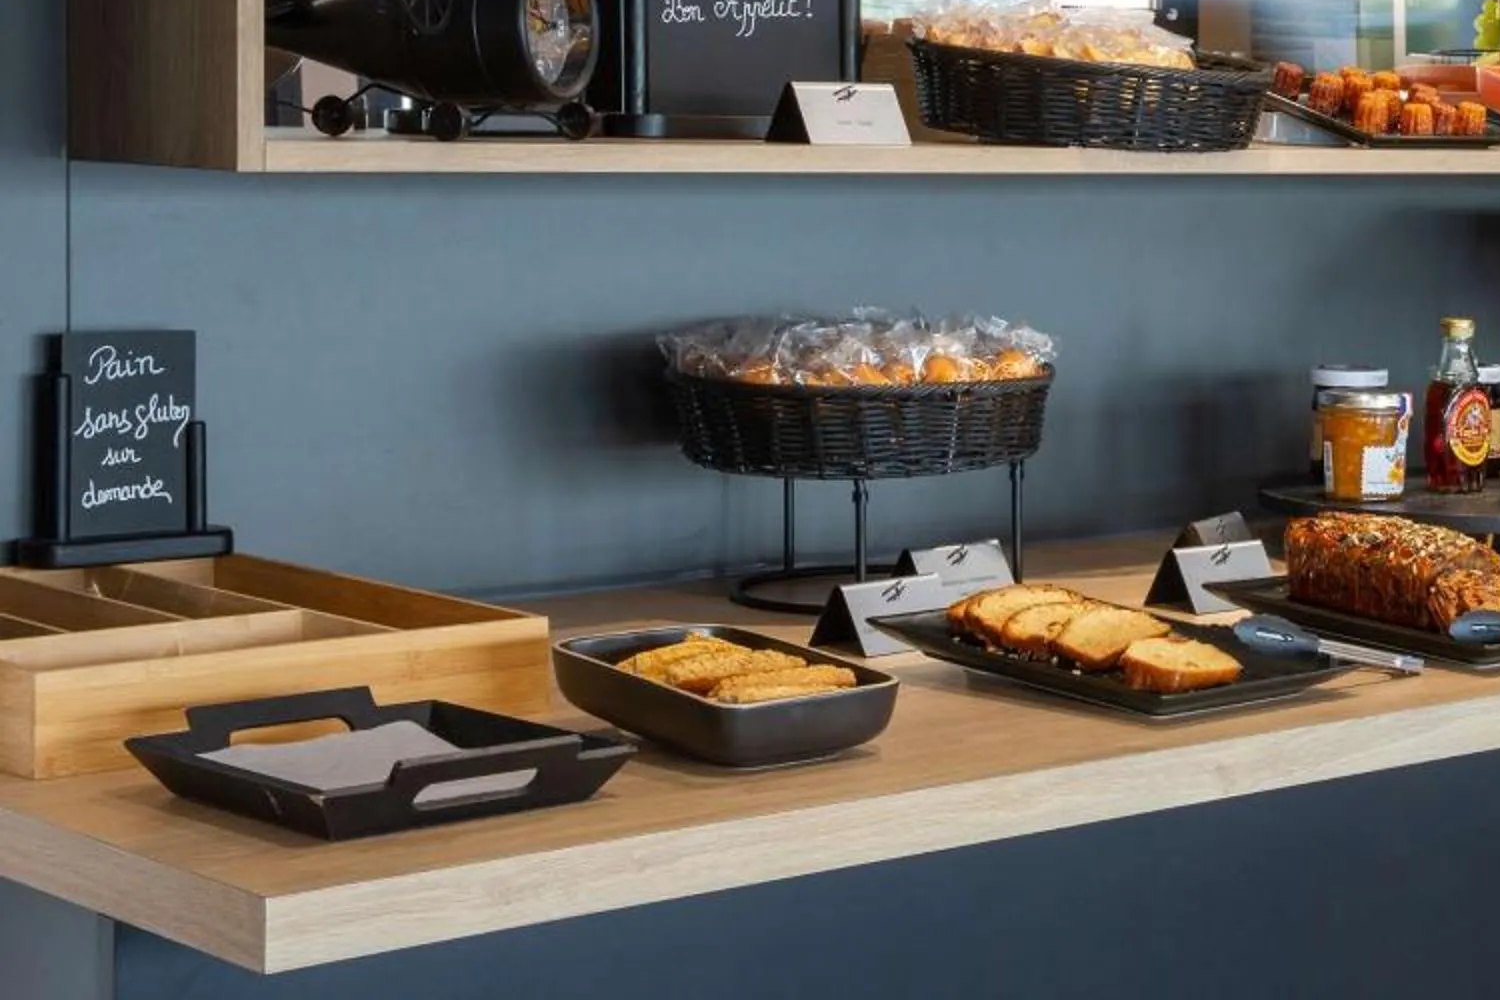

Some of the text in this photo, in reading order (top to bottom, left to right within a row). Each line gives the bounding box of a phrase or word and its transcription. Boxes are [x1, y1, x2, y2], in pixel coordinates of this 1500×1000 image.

[83, 345, 166, 385] Pain
[73, 406, 134, 440] sans
[101, 447, 142, 467] sur
[81, 475, 173, 509] demande
